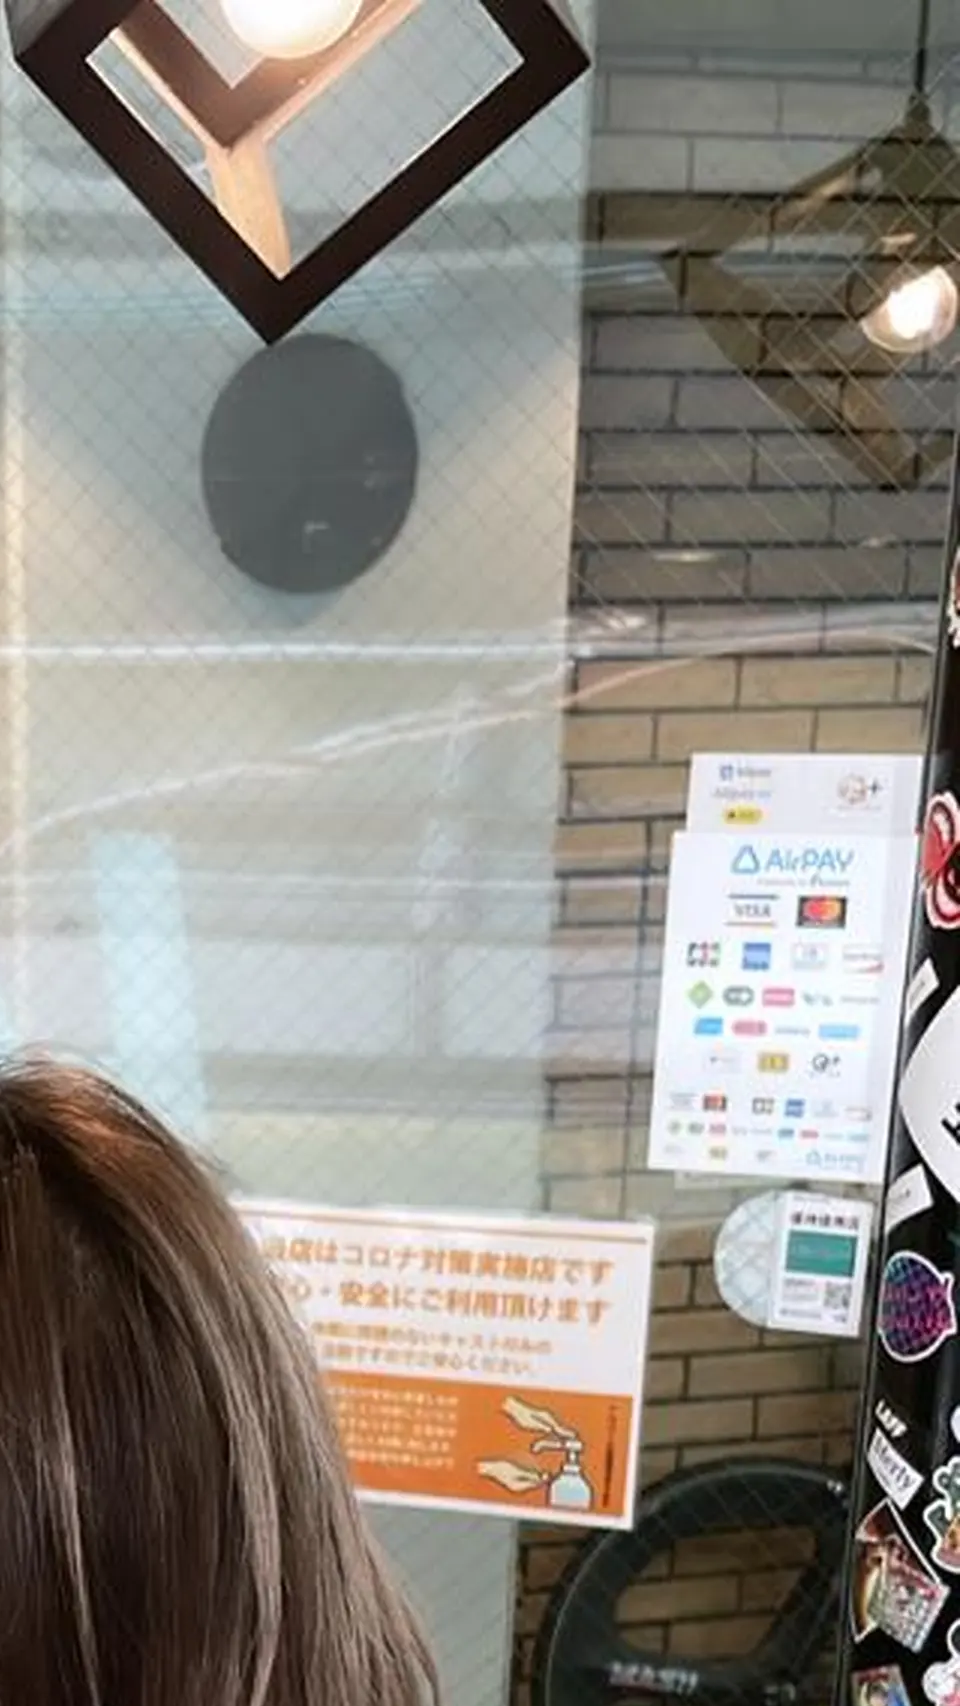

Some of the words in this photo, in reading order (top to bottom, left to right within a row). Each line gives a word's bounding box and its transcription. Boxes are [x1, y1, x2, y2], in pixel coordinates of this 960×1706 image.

[764, 847, 855, 875] AirPAY
[733, 904, 772, 919] VISA
[278, 1275, 613, 1325] 心・安全にご利用頂けます
